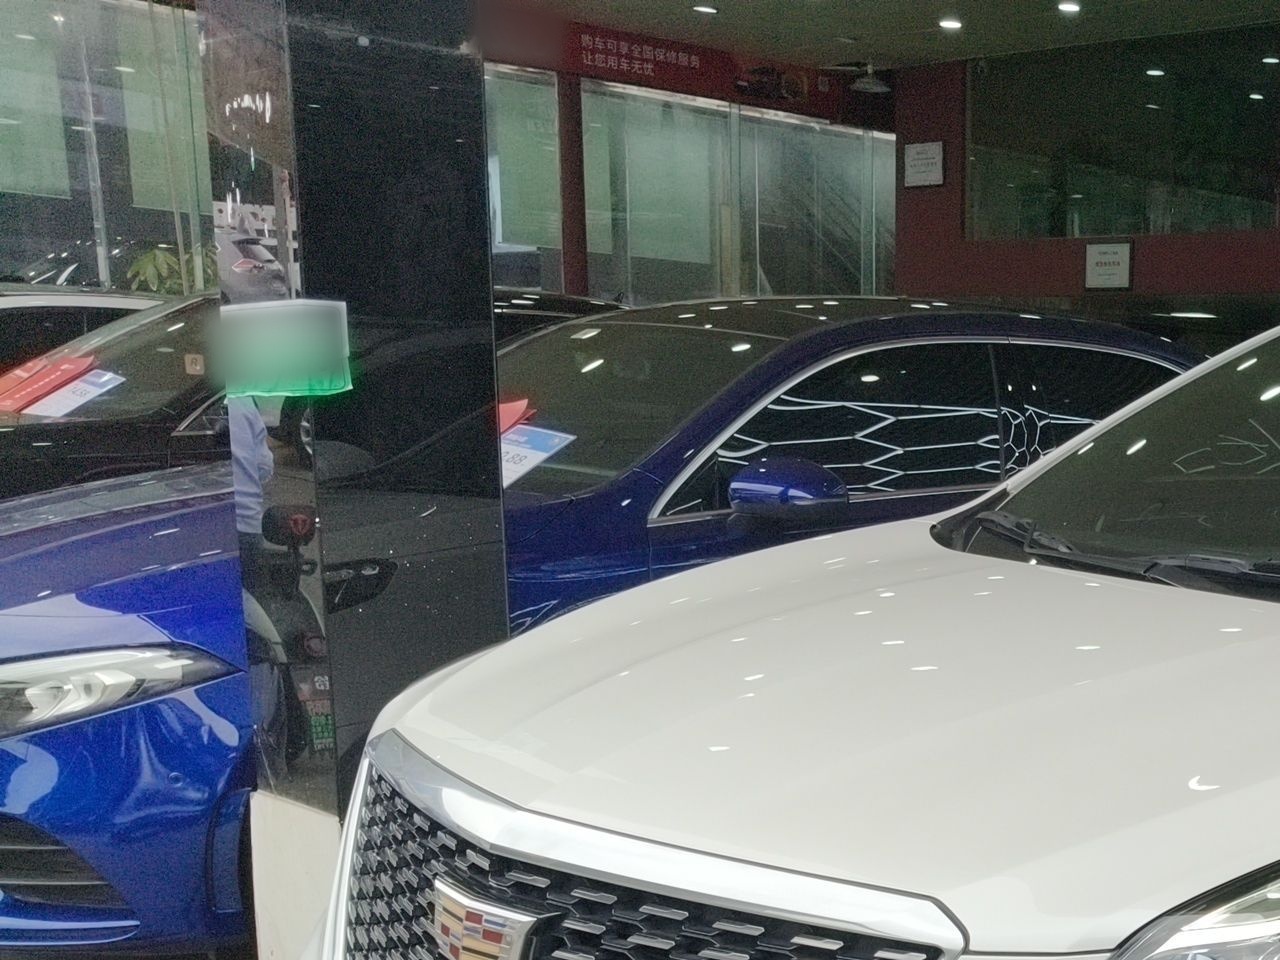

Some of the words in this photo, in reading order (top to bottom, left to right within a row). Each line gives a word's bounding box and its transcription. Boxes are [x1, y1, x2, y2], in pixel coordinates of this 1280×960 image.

[581, 33, 700, 69] 购车可享全国保修服务
[582, 51, 655, 76] 让您用车无忧
